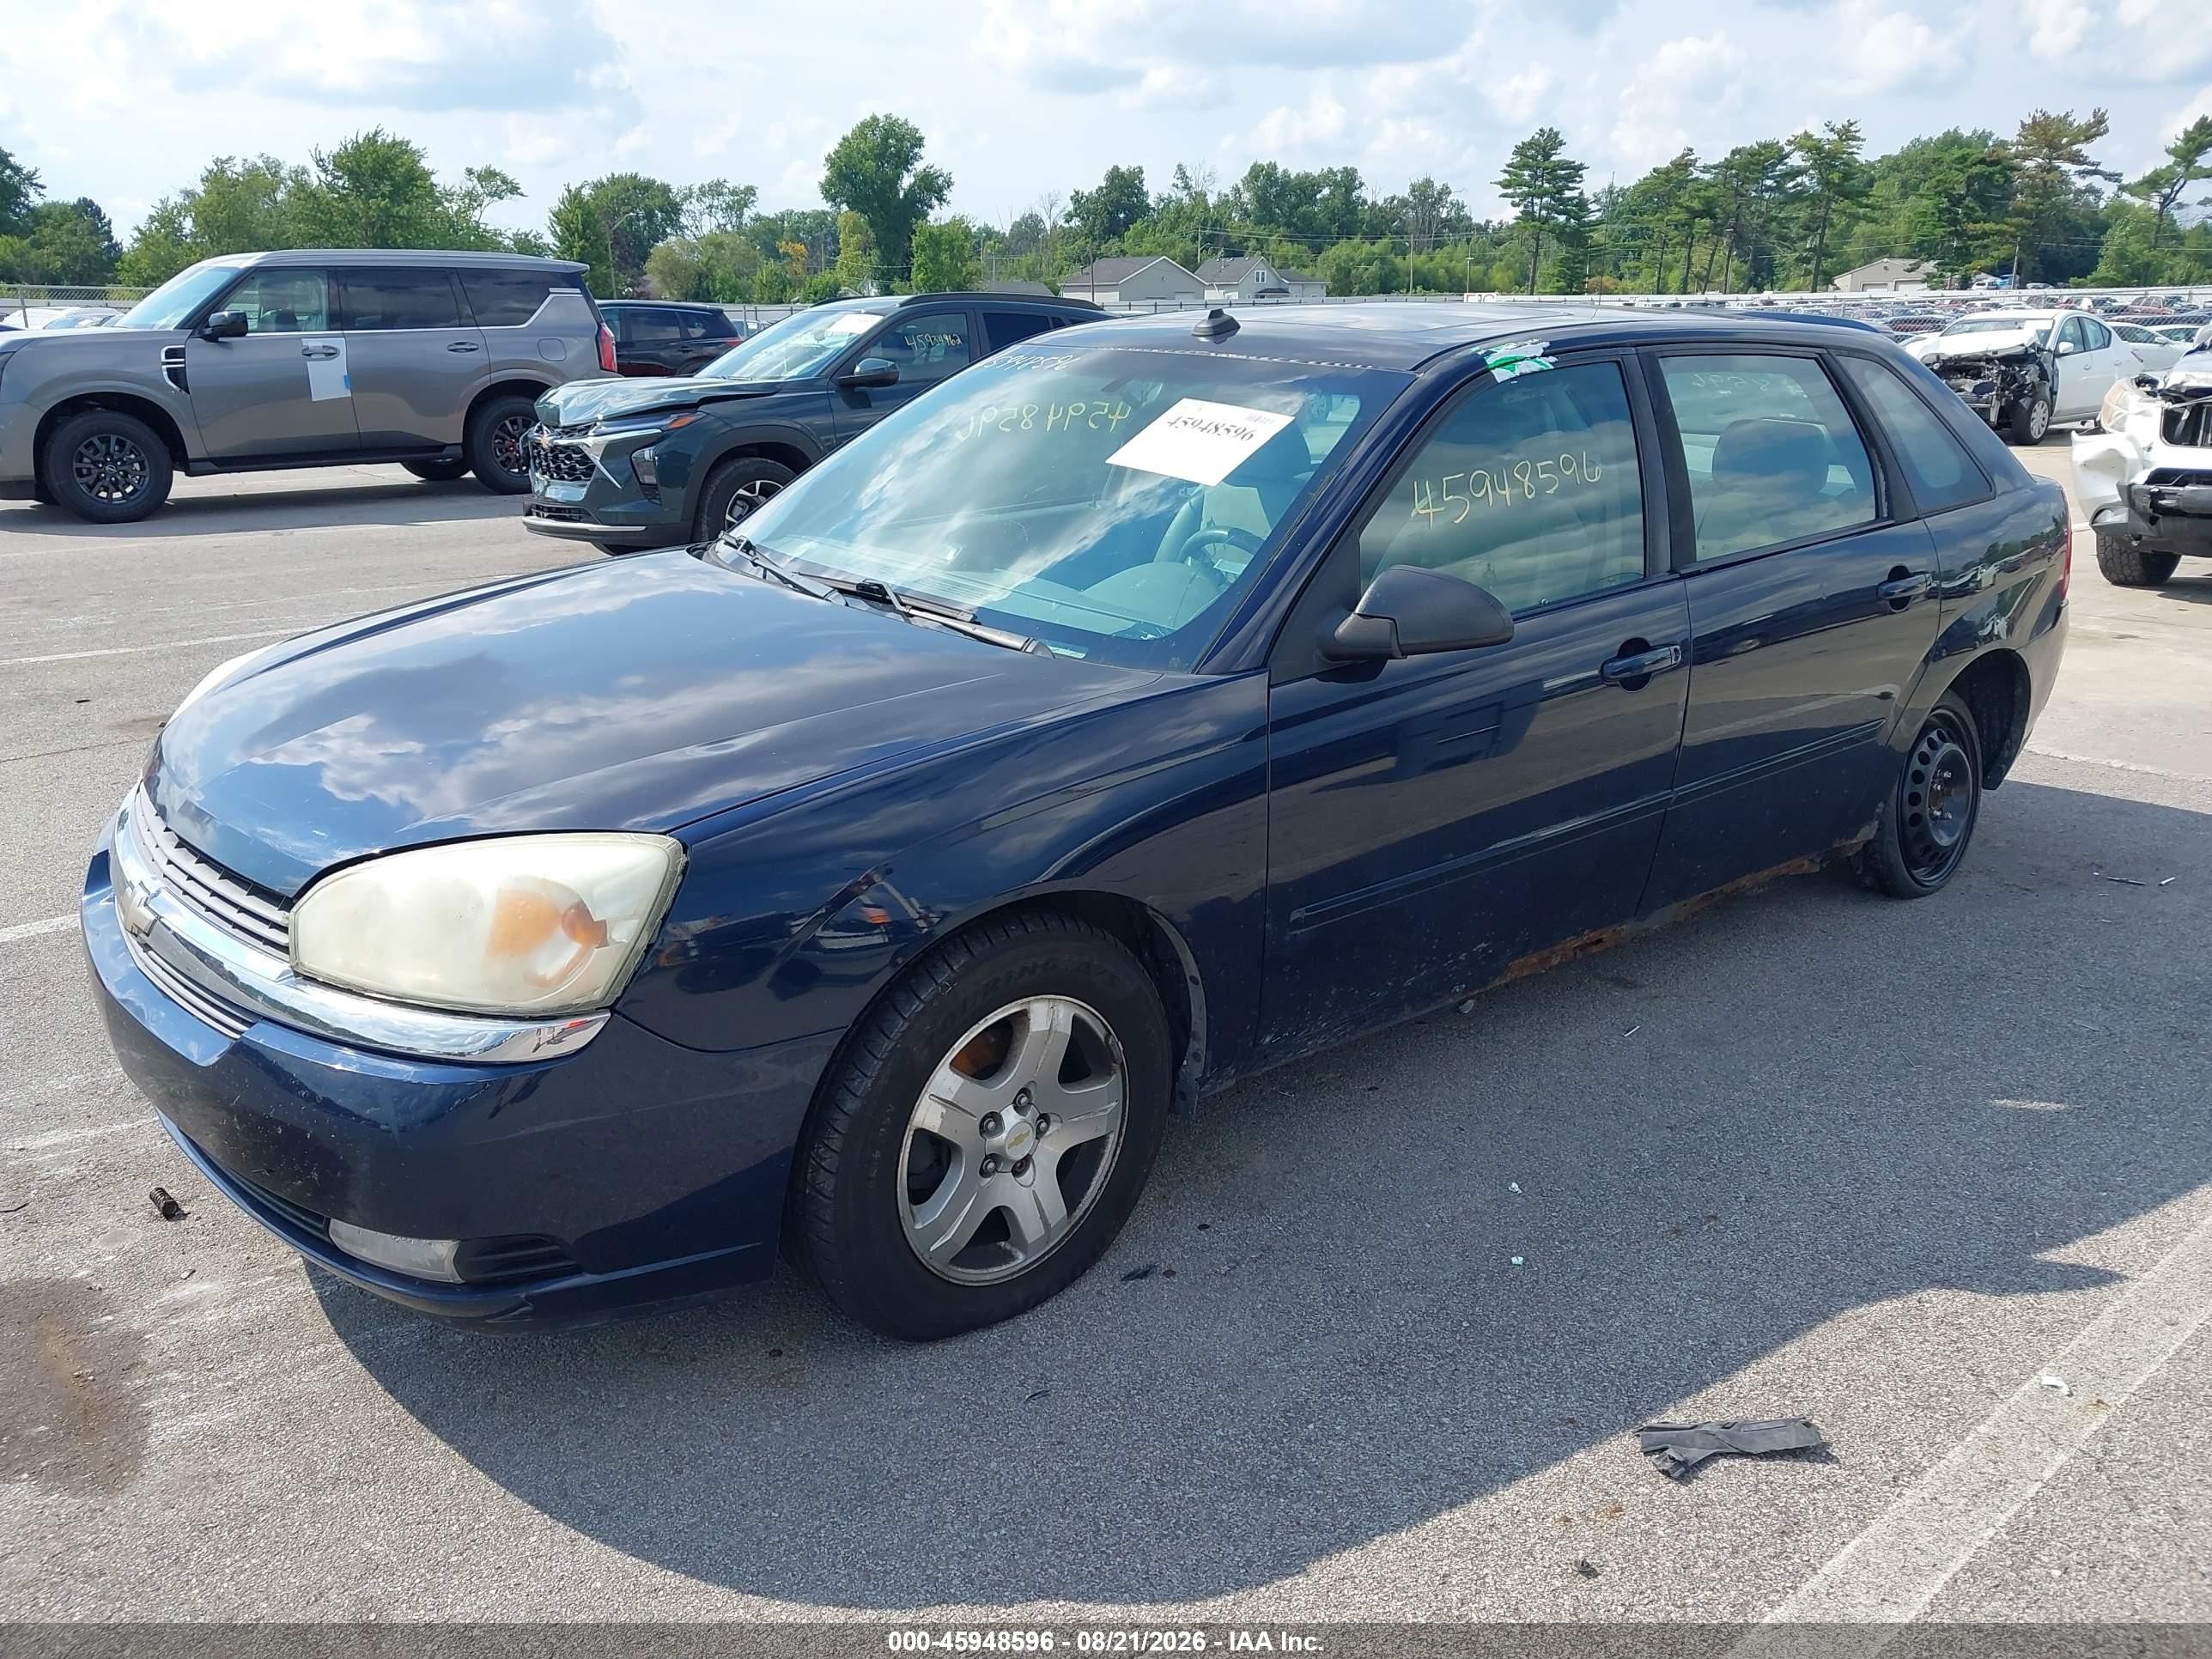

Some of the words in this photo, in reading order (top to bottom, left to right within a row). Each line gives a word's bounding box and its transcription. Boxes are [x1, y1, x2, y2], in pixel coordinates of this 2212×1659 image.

[904, 332, 963, 350] 45934962
[983, 354, 1080, 371] 5948596
[1166, 415, 1255, 441] 45948596
[1411, 450, 1602, 530] 45948596
